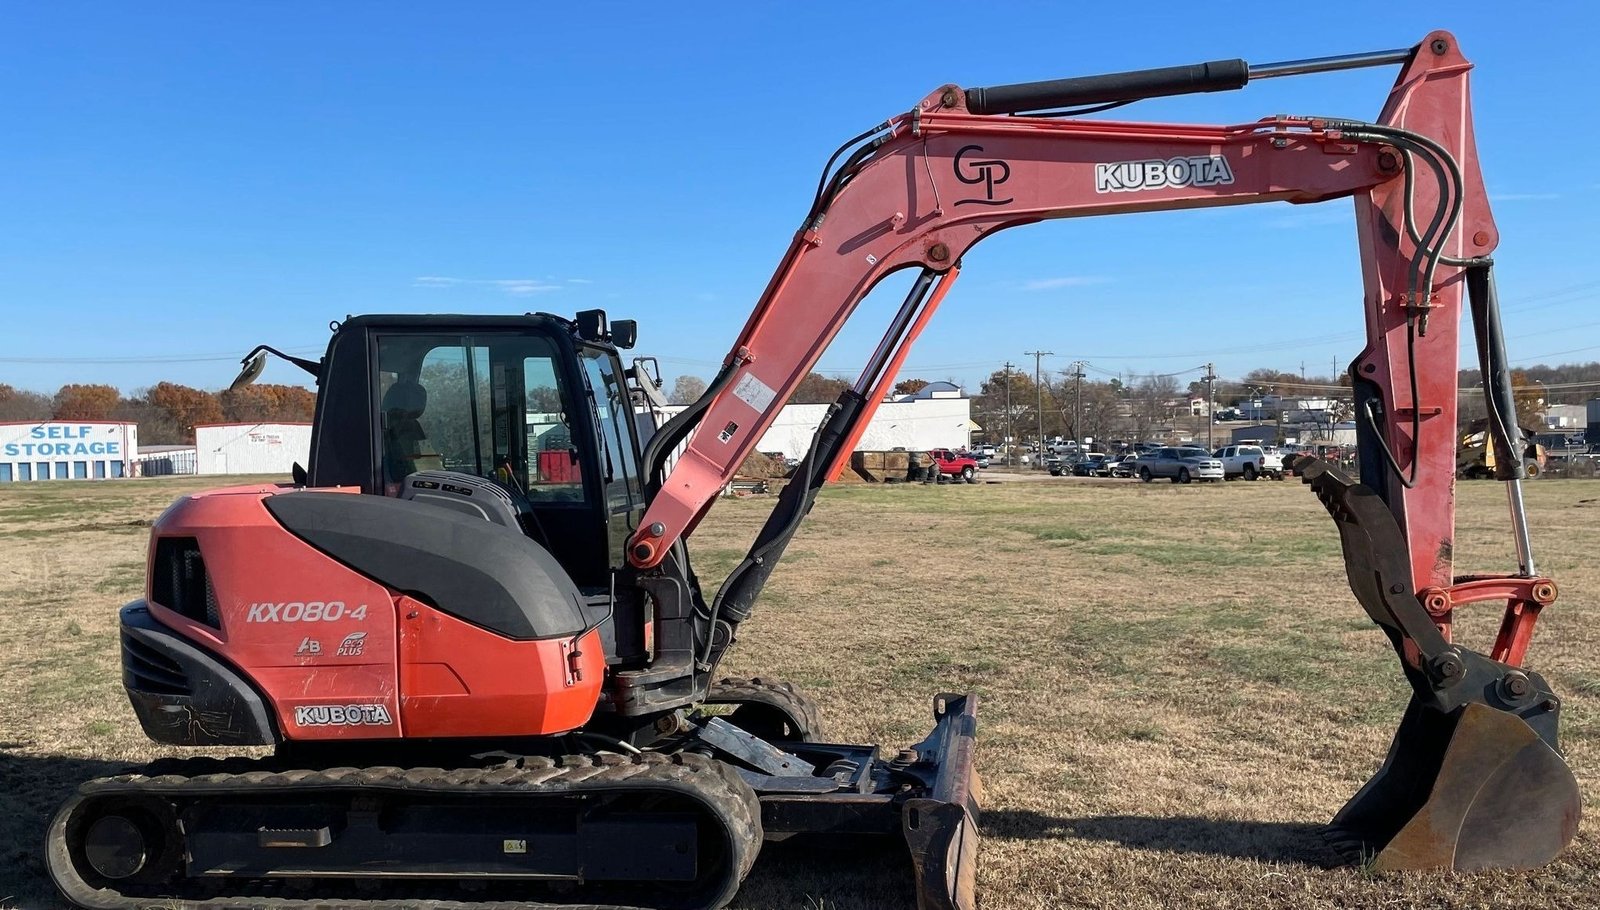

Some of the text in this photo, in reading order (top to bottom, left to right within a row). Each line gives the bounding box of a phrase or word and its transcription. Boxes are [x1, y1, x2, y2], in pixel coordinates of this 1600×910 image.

[1097, 155, 1232, 190] KUBOTA
[31, 426, 92, 439] SELF
[5, 442, 119, 456] STORAGE
[247, 601, 368, 623] KX080-4
[336, 647, 364, 656] PLUS
[296, 705, 391, 724] KUBOTA
